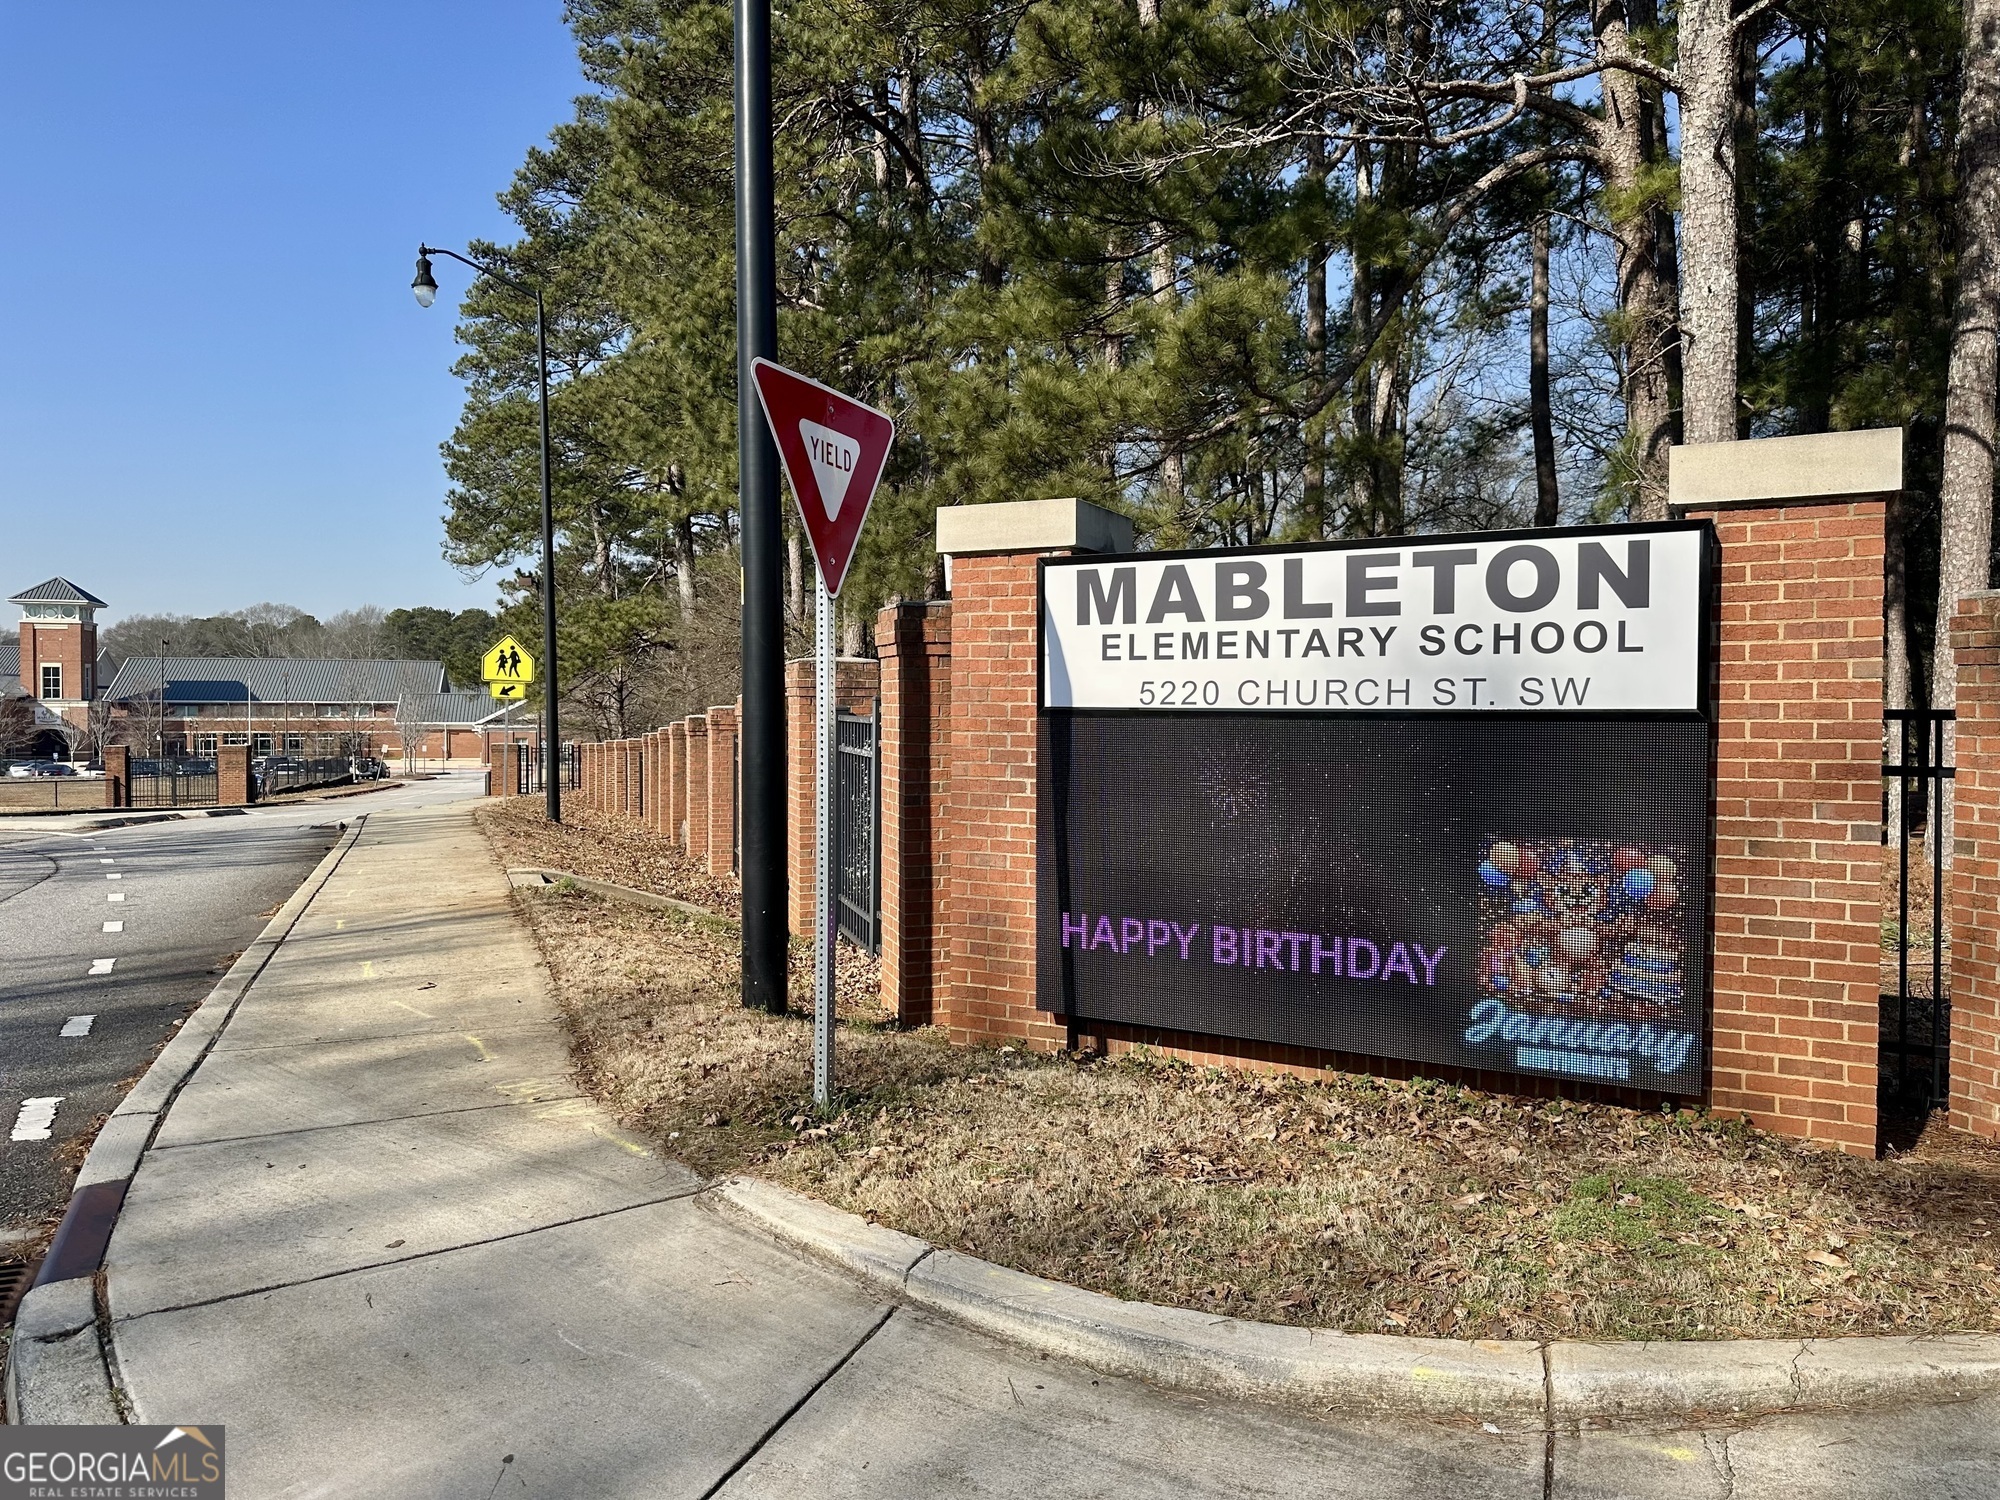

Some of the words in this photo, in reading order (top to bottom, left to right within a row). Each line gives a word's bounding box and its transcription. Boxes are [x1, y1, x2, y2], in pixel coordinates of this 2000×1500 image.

[810, 435, 852, 473] YIELD
[1076, 539, 1650, 626] MABLETON
[1101, 626, 1398, 661] ELEMENTARY
[1419, 620, 1644, 656] SCHOOL
[1139, 680, 1221, 706] 5220
[1237, 677, 1411, 706] CHURCH
[1432, 677, 1495, 706] ST.
[1519, 676, 1592, 706] SW
[1061, 911, 1199, 961] HAPPY
[1212, 925, 1448, 987] BIRTHDAY
[1465, 998, 1695, 1074] January
